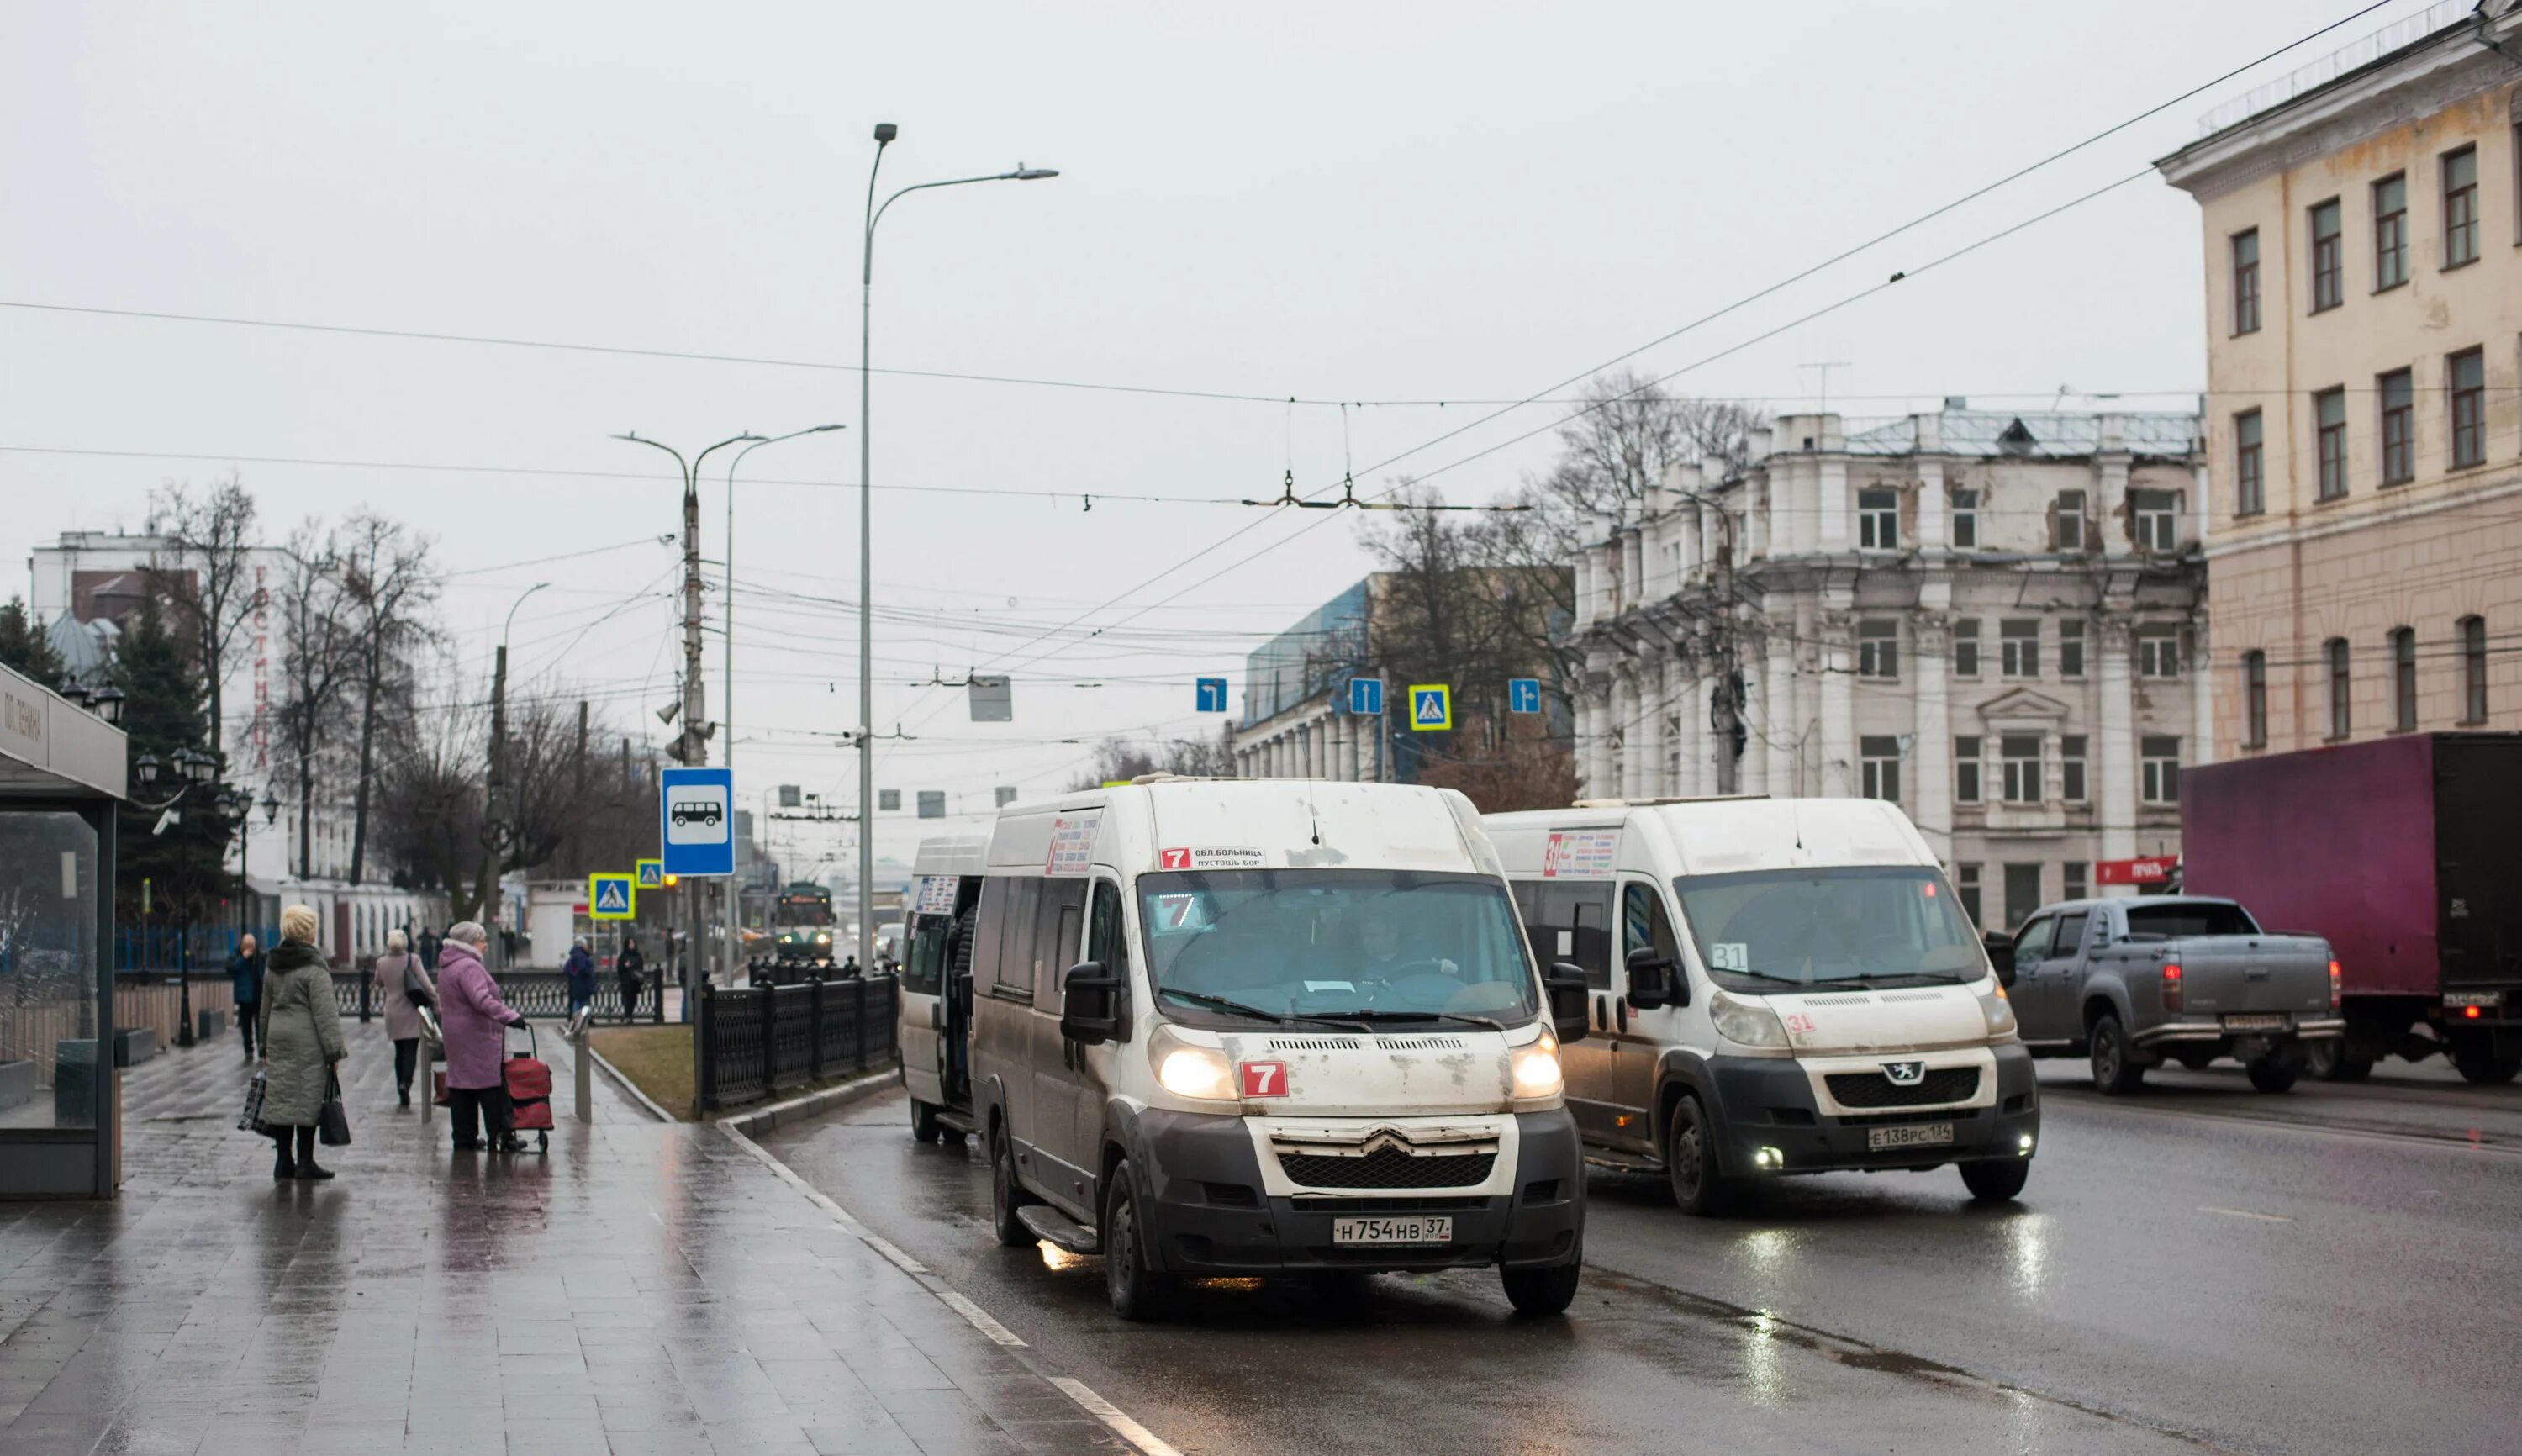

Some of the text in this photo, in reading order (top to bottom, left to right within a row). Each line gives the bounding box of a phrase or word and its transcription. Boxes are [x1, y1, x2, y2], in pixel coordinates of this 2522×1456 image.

[255, 566, 269, 768] ГОСТИНИЦА
[1167, 850, 1184, 868] 7
[1545, 841, 1560, 870] 31
[1159, 893, 1195, 926] 7
[1714, 946, 1746, 969] 31
[1786, 1012, 1815, 1033] 31
[1251, 1065, 1276, 1093] 7
[1427, 1219, 1445, 1233] 37
